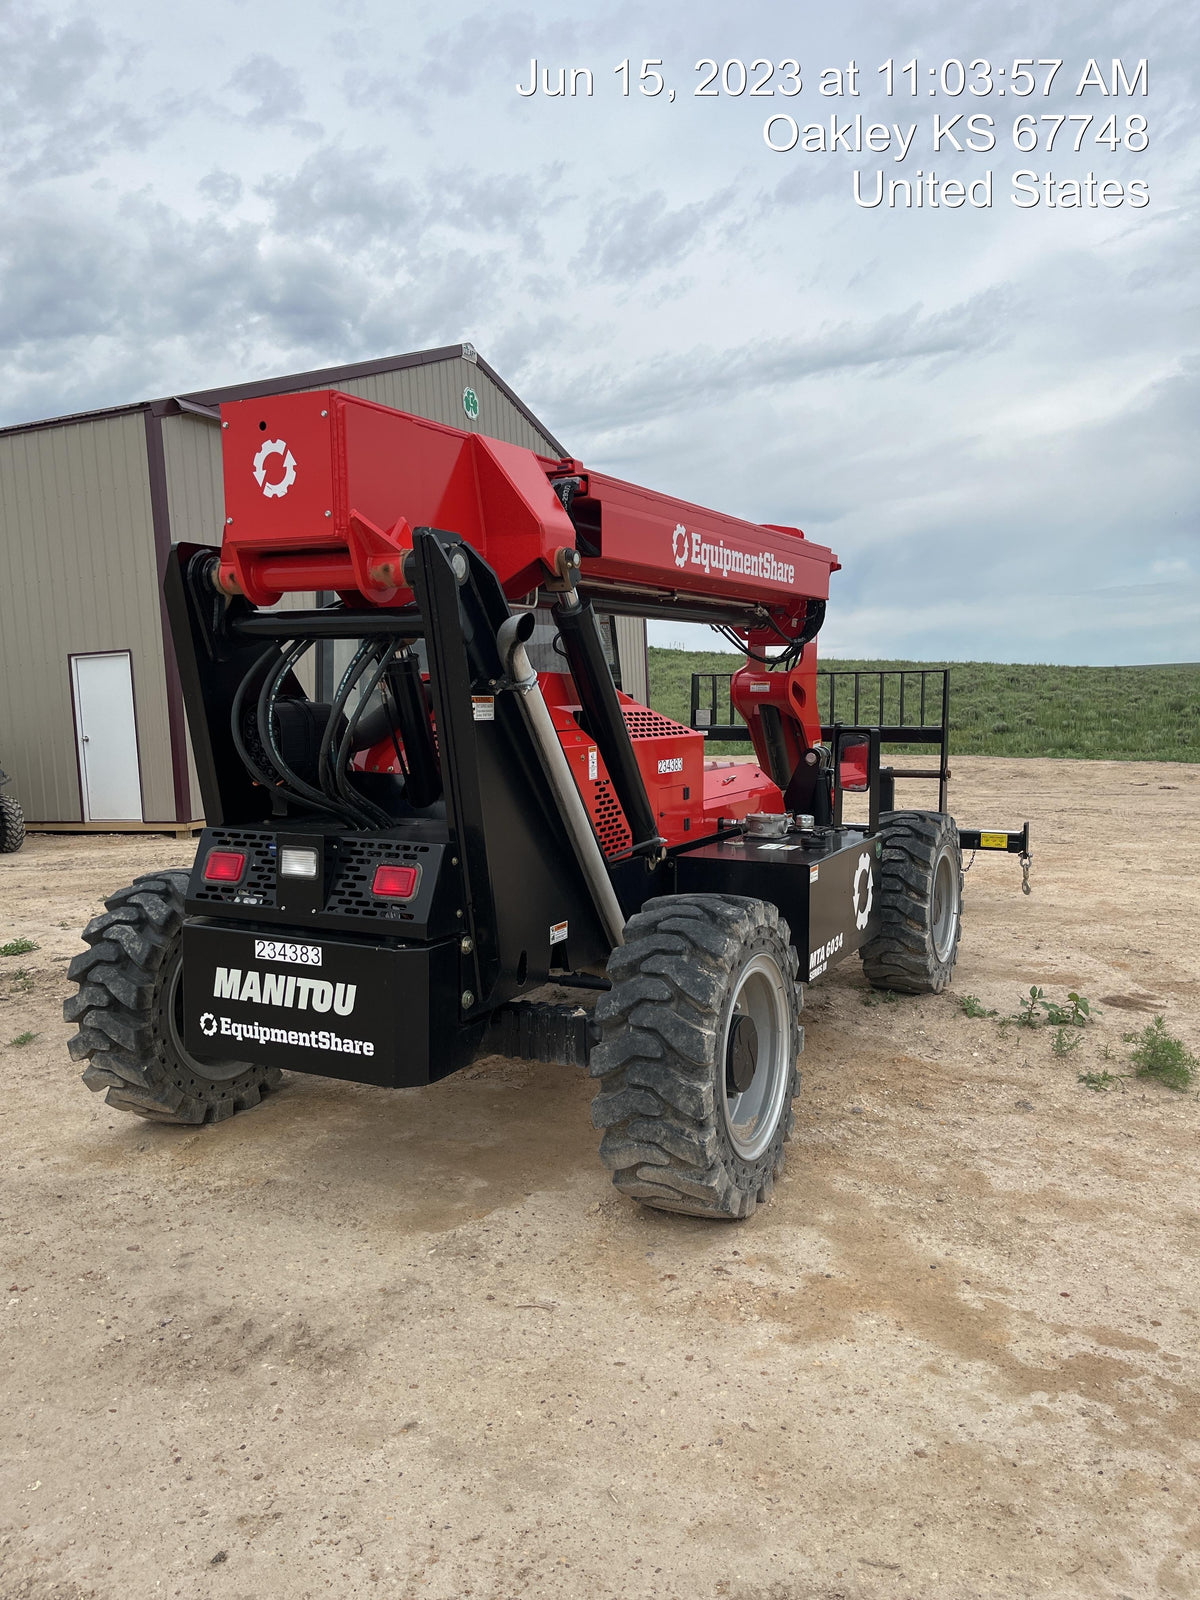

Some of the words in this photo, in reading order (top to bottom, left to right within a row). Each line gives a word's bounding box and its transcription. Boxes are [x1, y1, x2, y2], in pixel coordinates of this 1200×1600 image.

[691, 532, 795, 584] EquipmentShare
[658, 758, 682, 774] 234383
[256, 941, 321, 964] 234383
[809, 945, 825, 969] MTA
[826, 932, 843, 958] 6034
[213, 967, 357, 1016] MANITOU
[219, 1016, 375, 1056] EquipmentShare
